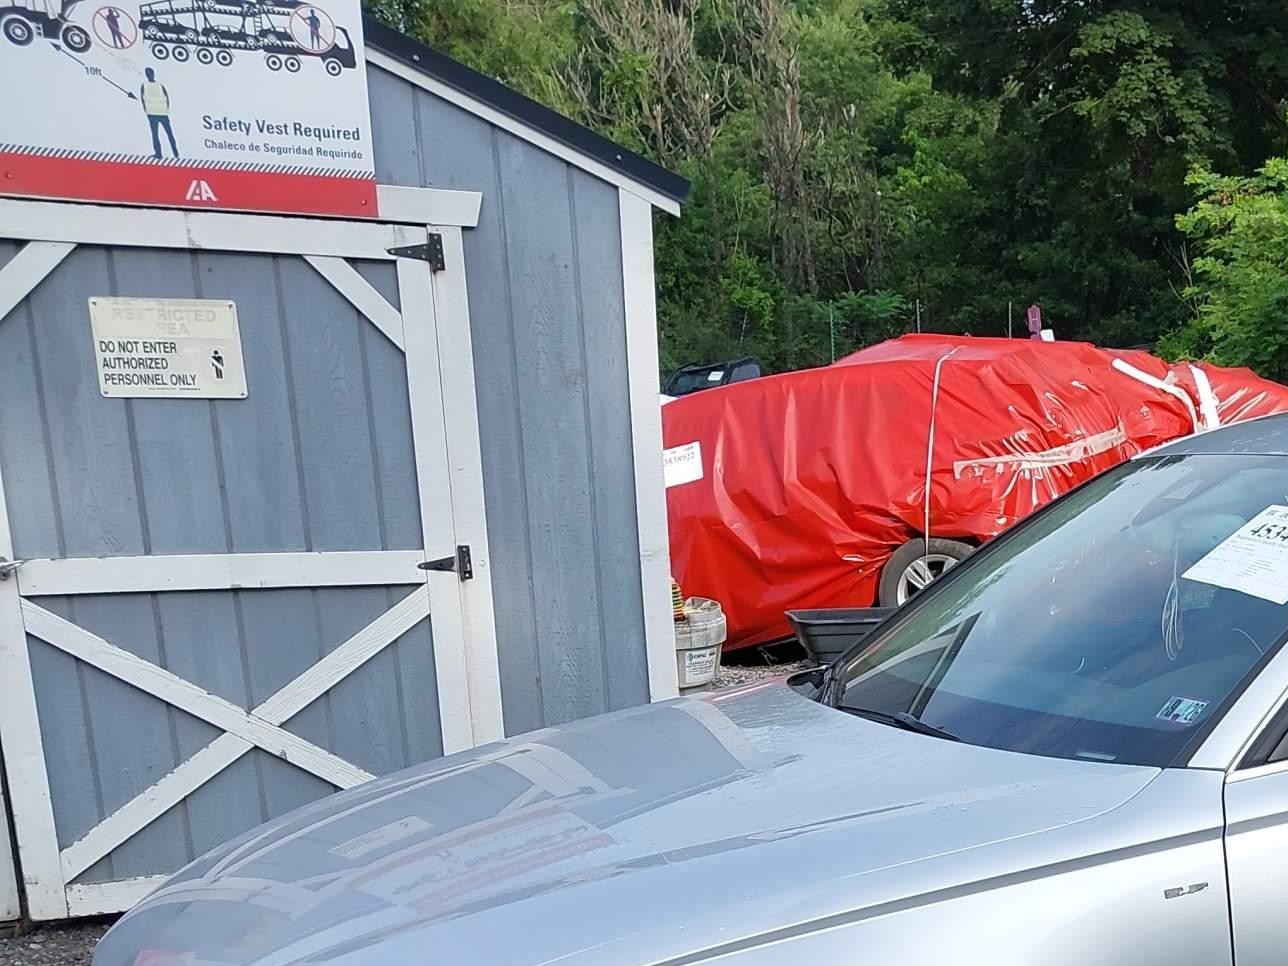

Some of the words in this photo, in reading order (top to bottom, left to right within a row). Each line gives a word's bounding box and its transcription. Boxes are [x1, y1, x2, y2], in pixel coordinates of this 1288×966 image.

[202, 115, 250, 136] Safety
[256, 119, 289, 135] Vest
[293, 122, 360, 141] Required
[204, 139, 245, 151] Chaleco
[248, 142, 260, 152] de
[263, 143, 313, 156] Seguridad
[316, 147, 362, 160] Requirido
[99, 340, 115, 353] DO
[117, 340, 140, 353] NOT
[142, 341, 177, 354] ENTER
[102, 357, 169, 370] AUTHORIZED
[104, 373, 168, 386] PERSONNEL
[170, 373, 197, 386] ONLY
